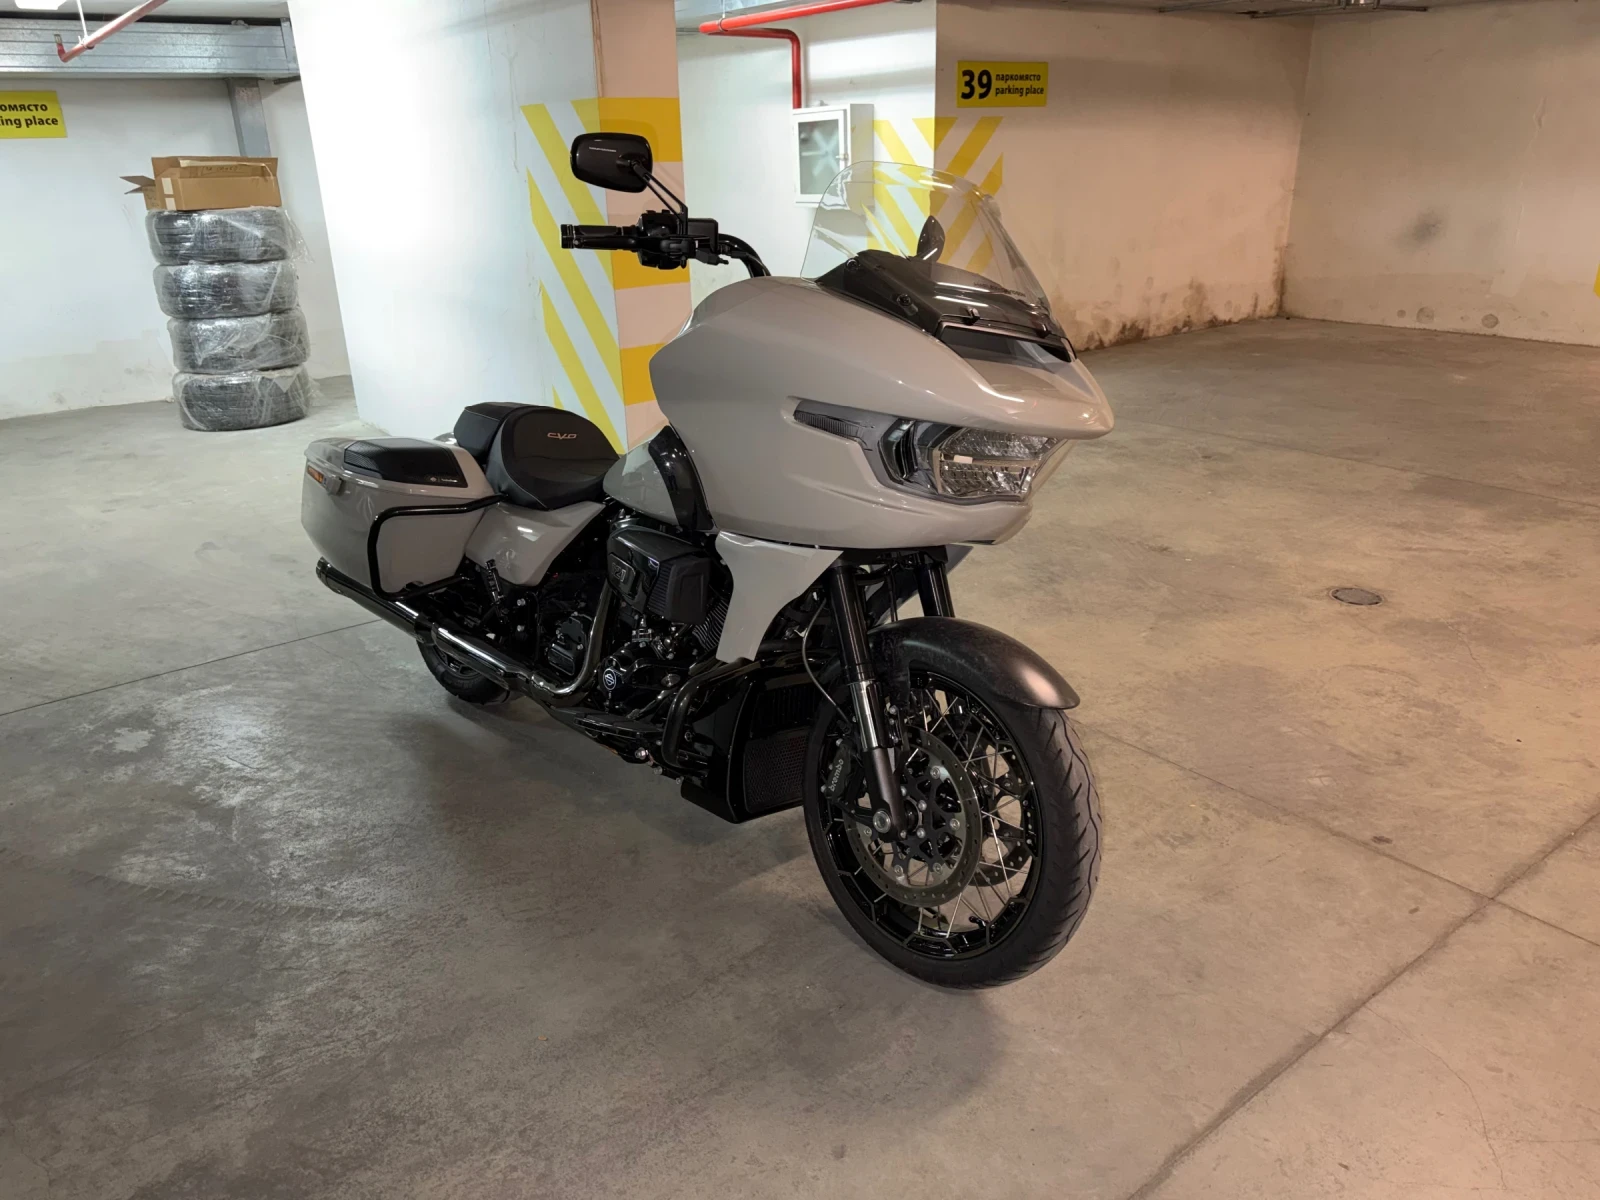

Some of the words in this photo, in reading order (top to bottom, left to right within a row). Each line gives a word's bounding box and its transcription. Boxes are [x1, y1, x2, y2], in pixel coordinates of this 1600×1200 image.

[961, 69, 992, 100] 39
[995, 74, 1041, 83] паркомясто
[995, 85, 1024, 97] parking
[1025, 85, 1044, 97] place
[0, 104, 48, 112] омясто
[0, 115, 22, 128] ing
[24, 115, 59, 128] place
[828, 758, 844, 792] brembo
